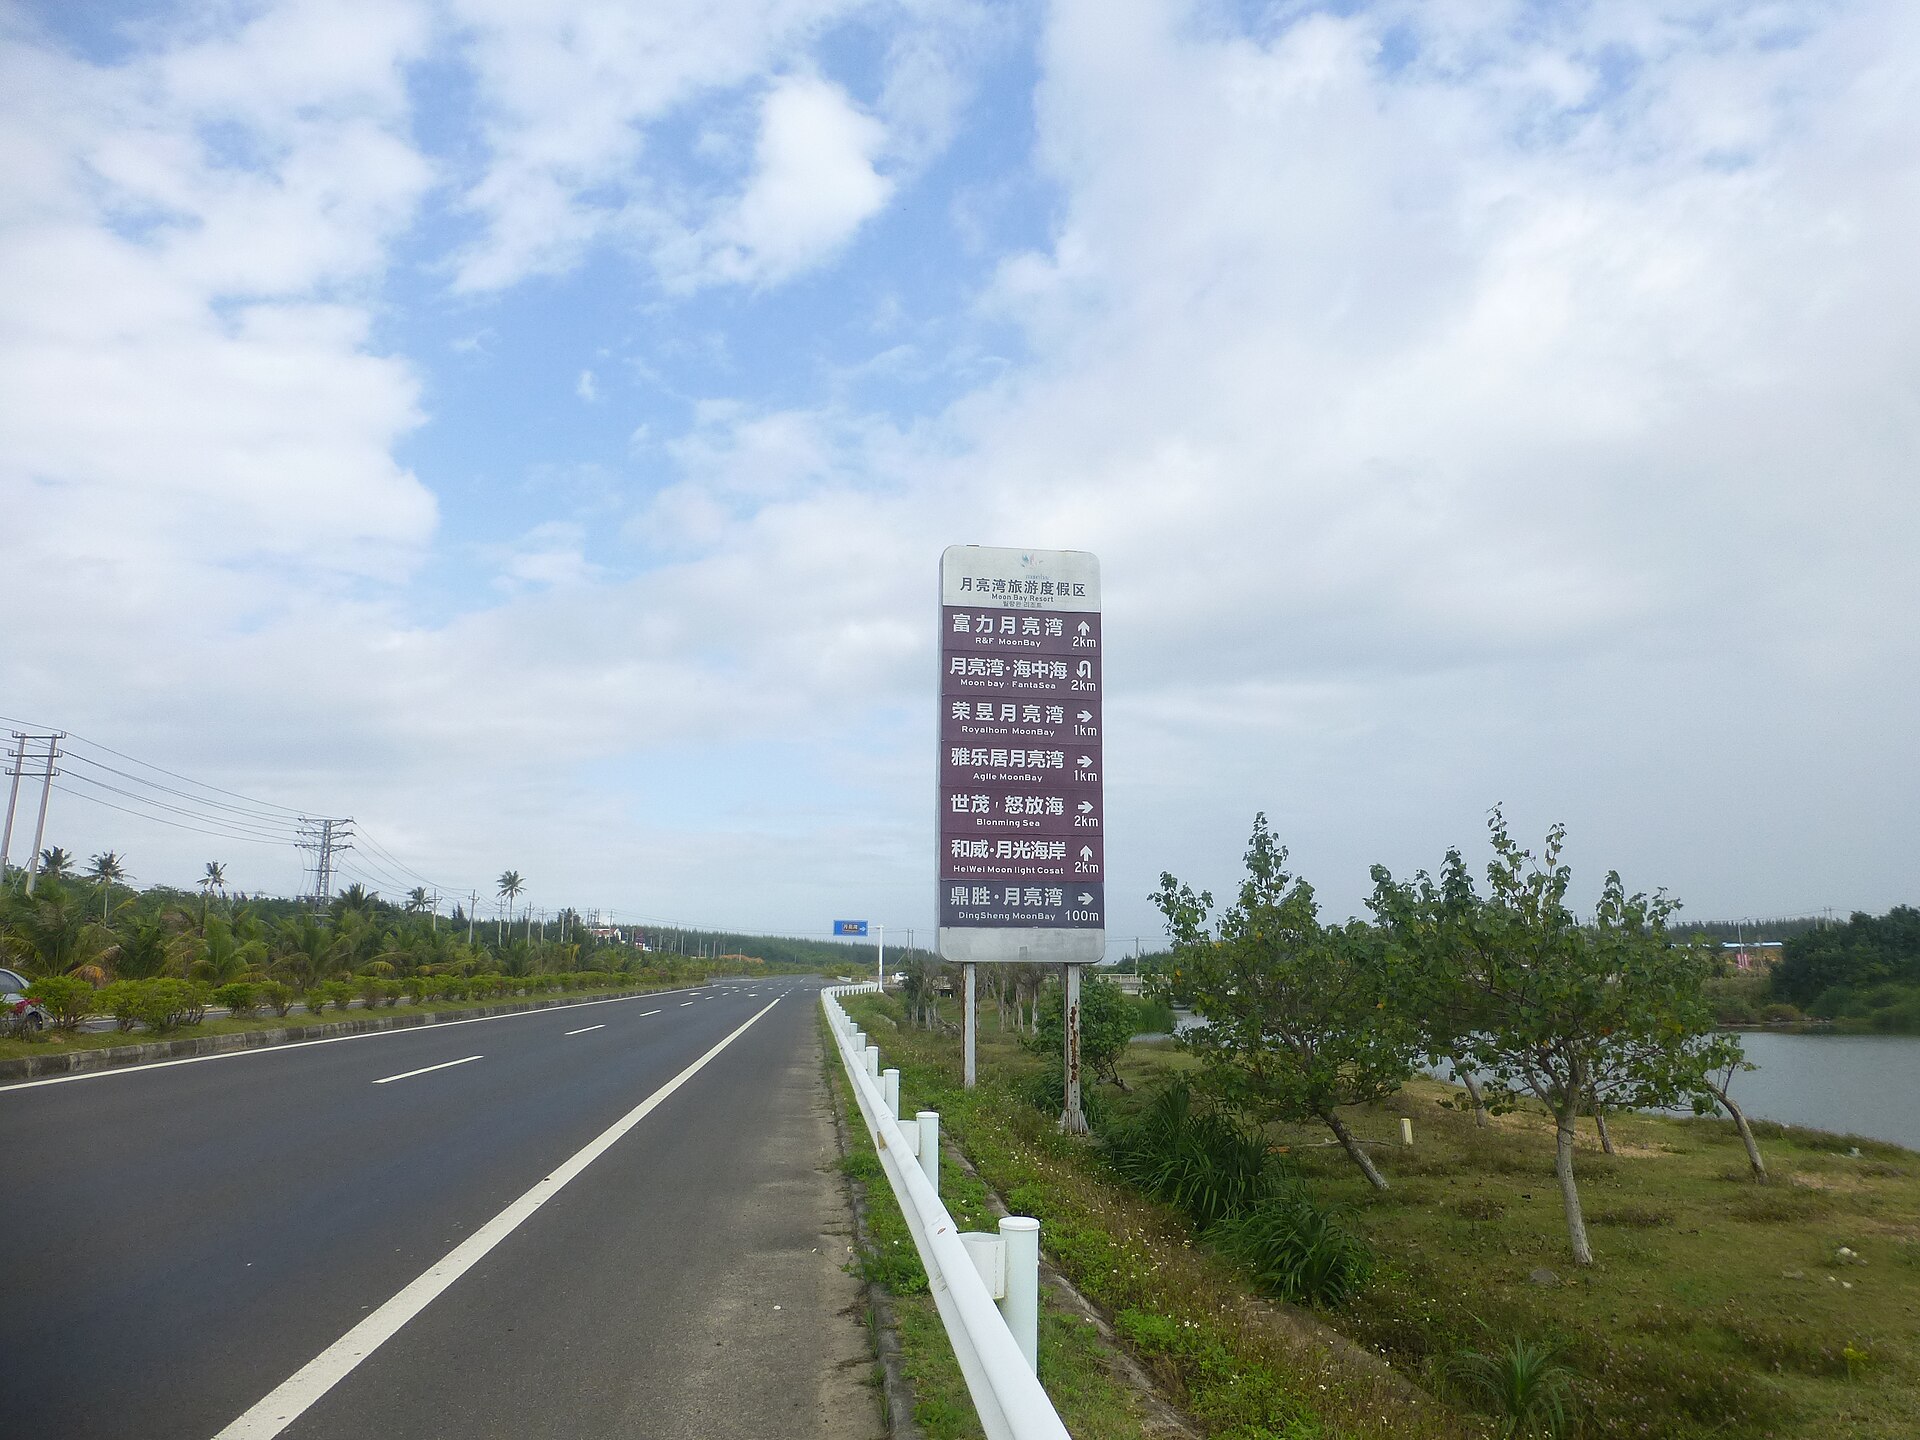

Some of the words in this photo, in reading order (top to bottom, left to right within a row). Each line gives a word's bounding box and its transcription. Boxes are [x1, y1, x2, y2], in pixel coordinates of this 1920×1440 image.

[960, 577, 1085, 596] 月亮湾旅游度假区
[953, 614, 1063, 636] 富力月亮湾
[999, 639, 1041, 647] MoonBay
[1072, 636, 1096, 647] 2km
[988, 680, 1004, 688] bay
[1012, 681, 1056, 689] FantaSea
[1071, 680, 1096, 691] 2km
[952, 702, 1064, 724] 荣昱月亮湾
[961, 726, 1007, 734] Royalhom
[1012, 728, 1055, 737] MoonBay
[1074, 725, 1097, 736] 1km
[951, 748, 1064, 769] 雅乐居月亮湾
[1000, 773, 1043, 782] MoonBay
[1074, 770, 1098, 781] 1km
[1023, 819, 1040, 827] Sea
[1074, 815, 1098, 827] 2km
[1037, 867, 1064, 875] Cosat
[1074, 861, 1099, 873] 2km
[959, 912, 1010, 921] DingSheng
[1012, 912, 1055, 921] MoonBay
[1065, 910, 1099, 921] 100m
